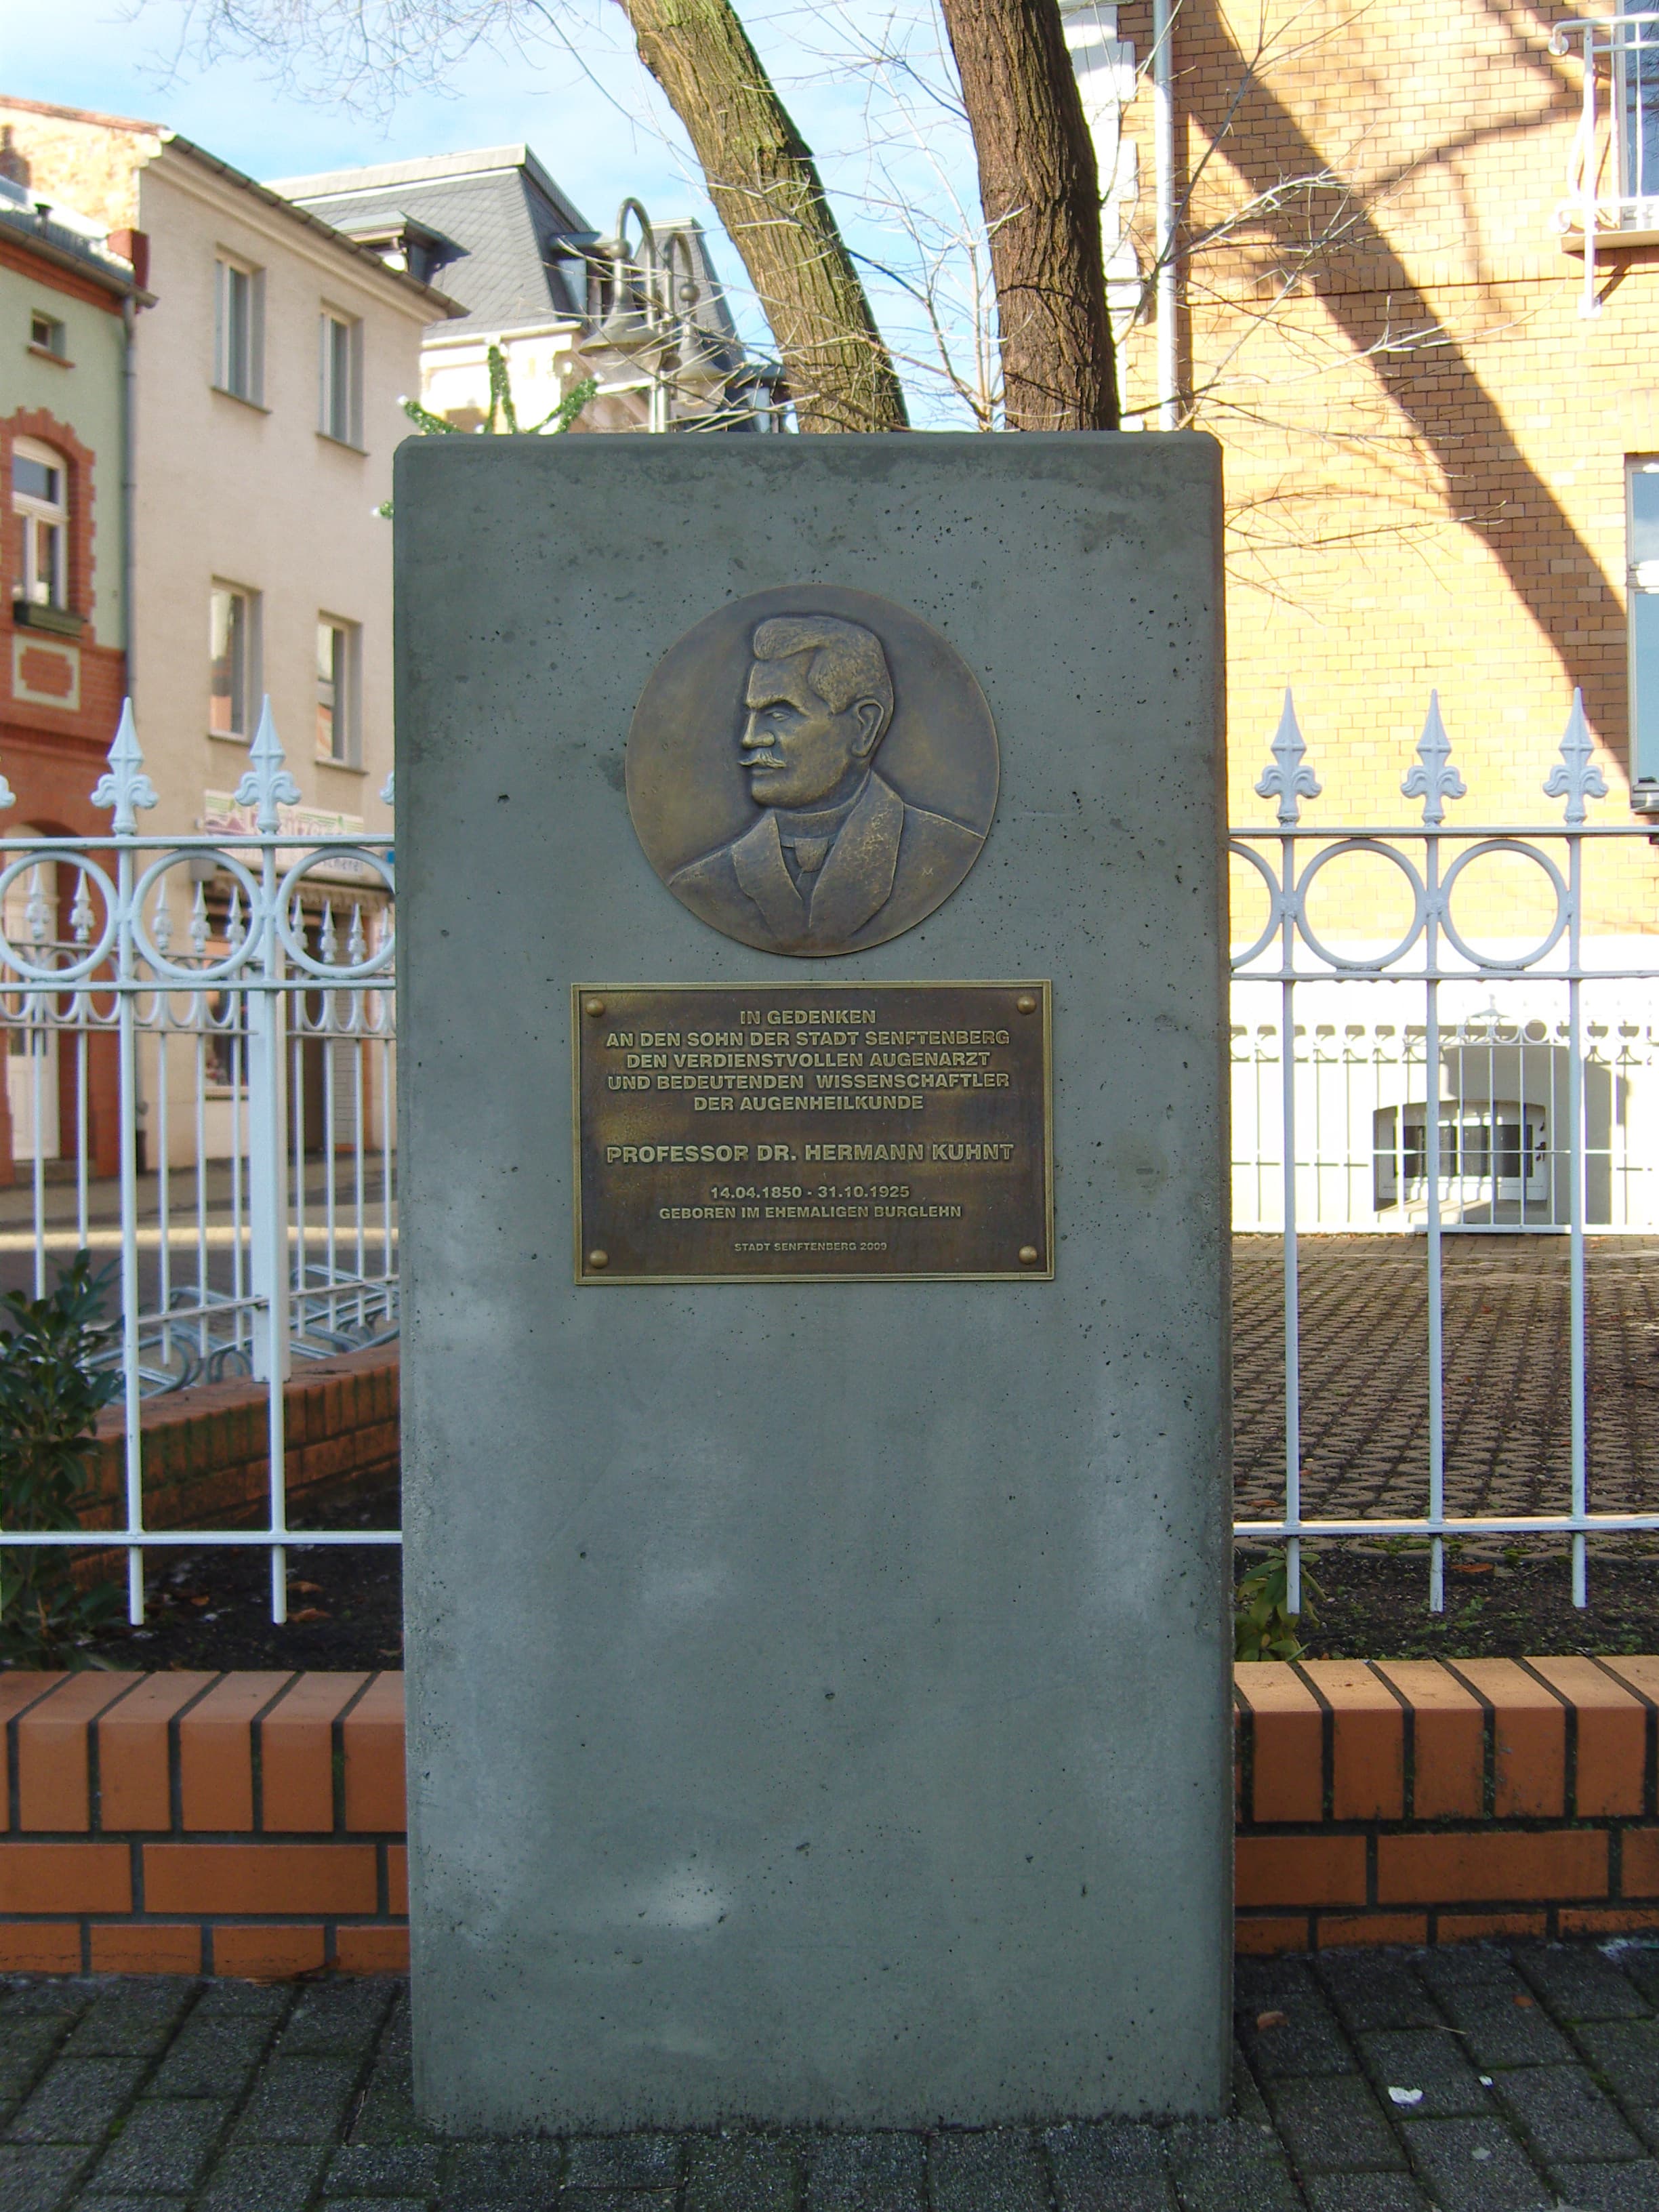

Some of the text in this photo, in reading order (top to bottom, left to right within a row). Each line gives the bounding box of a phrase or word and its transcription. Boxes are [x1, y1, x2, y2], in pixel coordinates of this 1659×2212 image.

[740, 1010, 876, 1025] IN GEDENKEN
[607, 1030, 1010, 1047] AN DEN SOHN DER STADT SENFTENBERG
[627, 1052, 990, 1069] DEN VERDIENSTVOLLEN AUGENARZT
[608, 1073, 1010, 1090] UND BEDEUTENDEN WISSENSCHAFTLER
[694, 1095, 924, 1111] DER AUGENHEILKUNDE
[607, 1143, 1015, 1163] PROFESSOR DR. HERMANN KUHNT
[711, 1187, 802, 1199] 14.04.1850
[818, 1186, 910, 1198] 31.10.1925
[659, 1206, 962, 1219] GEBOREN IM EHEMALIGEN BURGLEHN
[735, 1242, 887, 1251] STADT SENFTENBERG 2009
